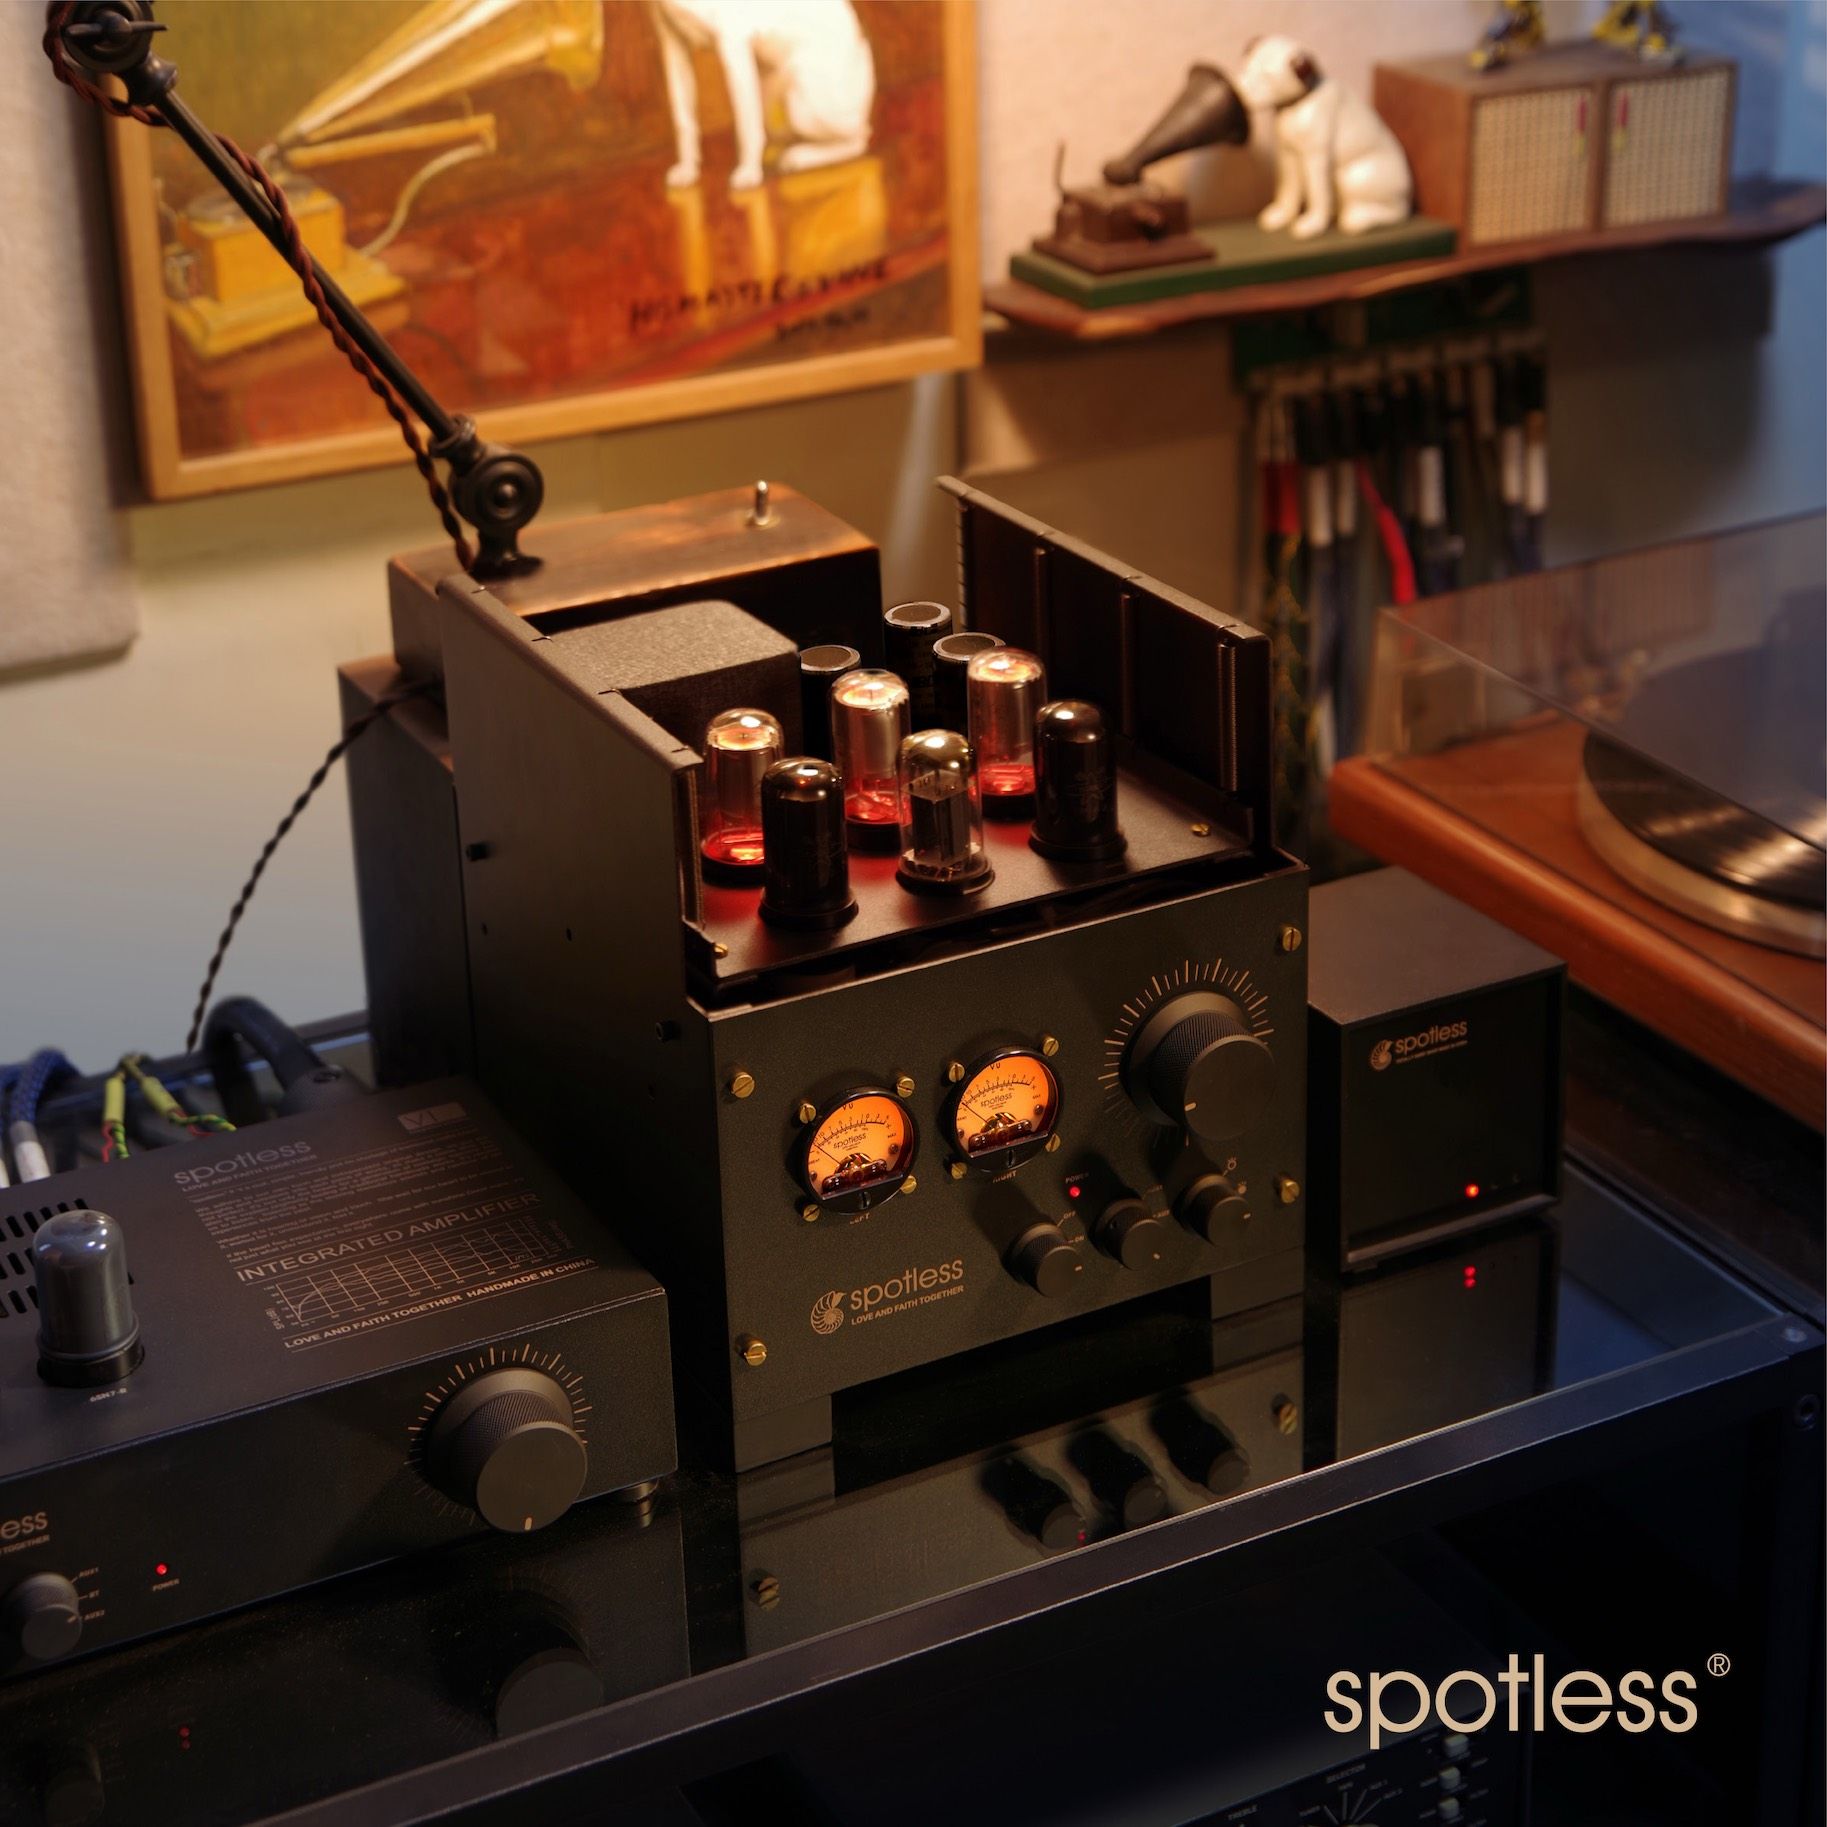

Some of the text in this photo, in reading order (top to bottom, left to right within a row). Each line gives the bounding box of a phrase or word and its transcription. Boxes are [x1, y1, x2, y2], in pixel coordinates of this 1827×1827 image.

[1395, 1021, 1468, 1055] spotless
[980, 1092, 1013, 1108] spotless
[833, 1132, 867, 1149] spotless
[174, 1141, 311, 1184] spotless
[236, 1230, 404, 1282] INTEGRATED
[409, 1191, 542, 1237] AMPLIFIER
[284, 1333, 322, 1349] LOVE
[323, 1325, 351, 1339] AND
[353, 1314, 391, 1330] FAITH
[391, 1294, 464, 1319] TOGETHER
[466, 1273, 540, 1298] HANDMADE
[539, 1269, 554, 1278] IN
[555, 1258, 596, 1273] CHINA
[850, 1259, 964, 1311] spotless
[851, 1284, 965, 1326] LOVE AND FAITH TOGETHER
